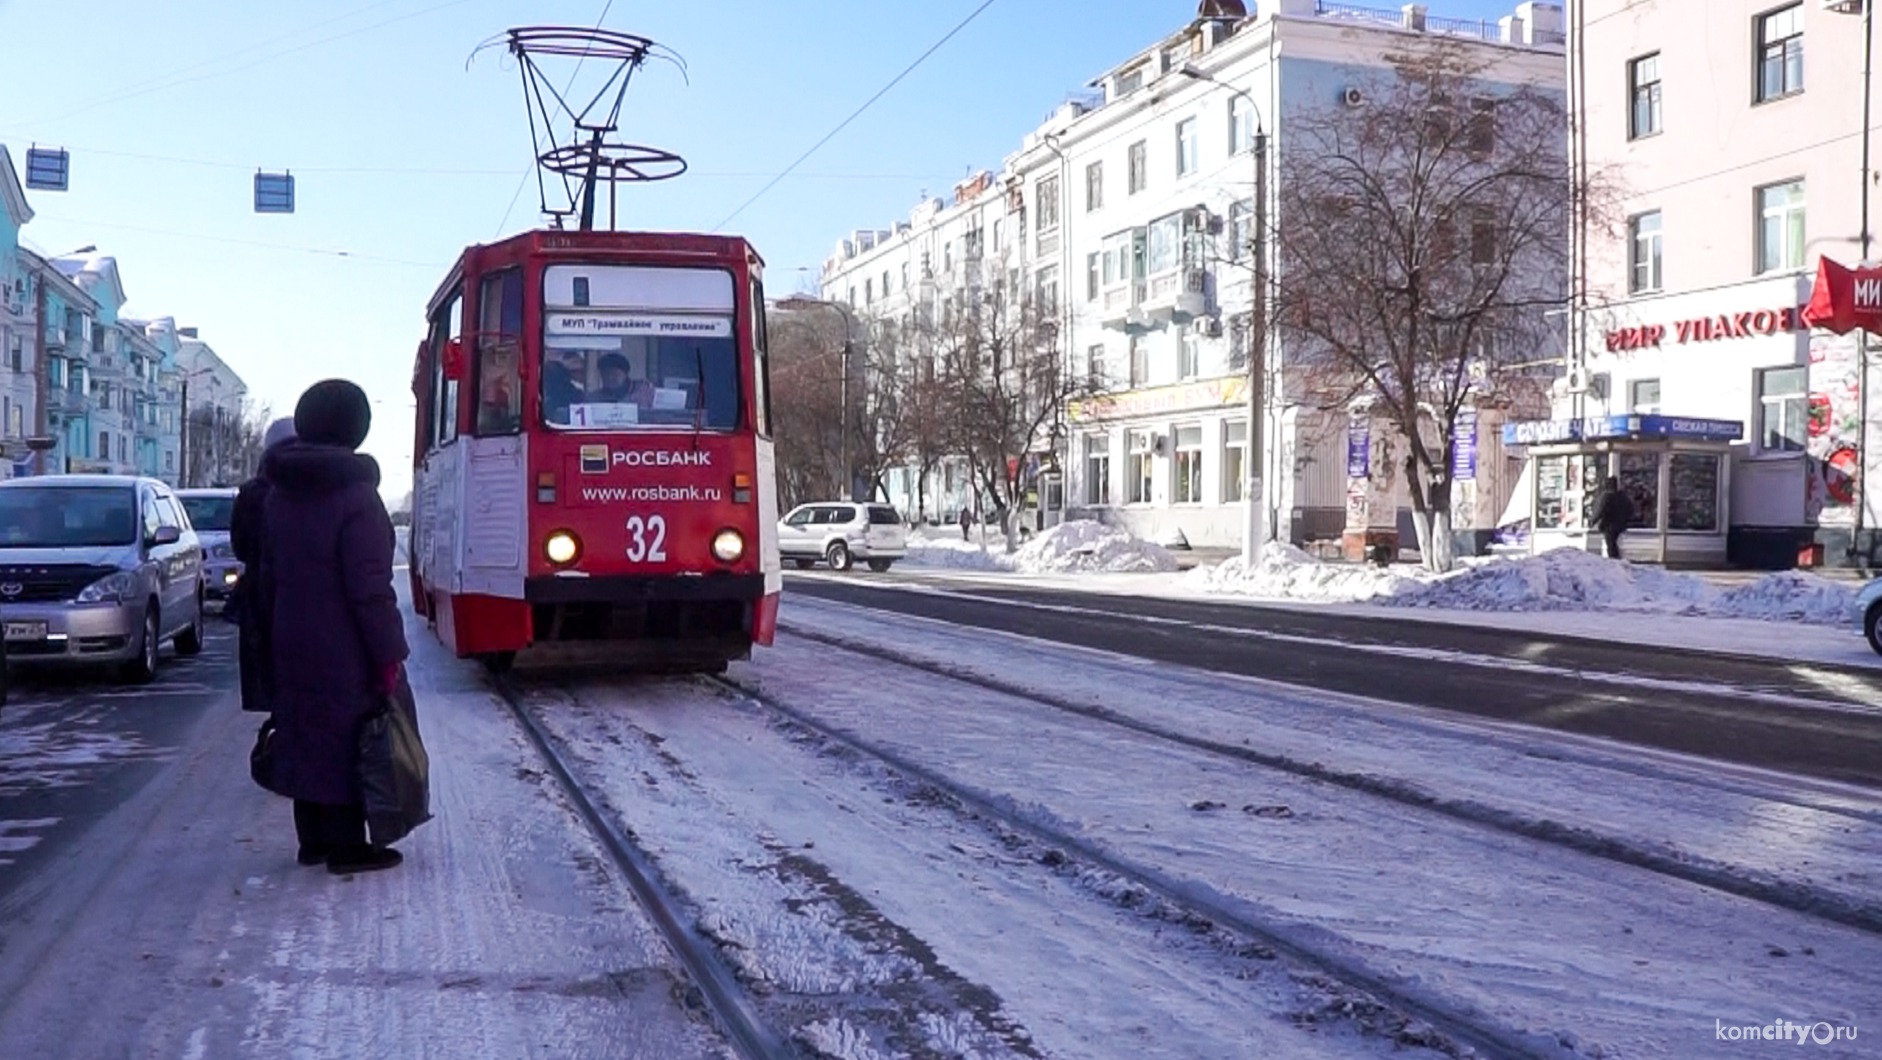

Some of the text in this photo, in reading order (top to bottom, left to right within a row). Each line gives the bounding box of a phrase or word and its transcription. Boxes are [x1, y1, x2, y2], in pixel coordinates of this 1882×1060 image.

[562, 319, 585, 328] МУП
[575, 406, 586, 427] 1
[612, 452, 711, 466] РОСБАНК
[583, 486, 721, 502] www.rosbank.ru
[626, 515, 666, 562] 32
